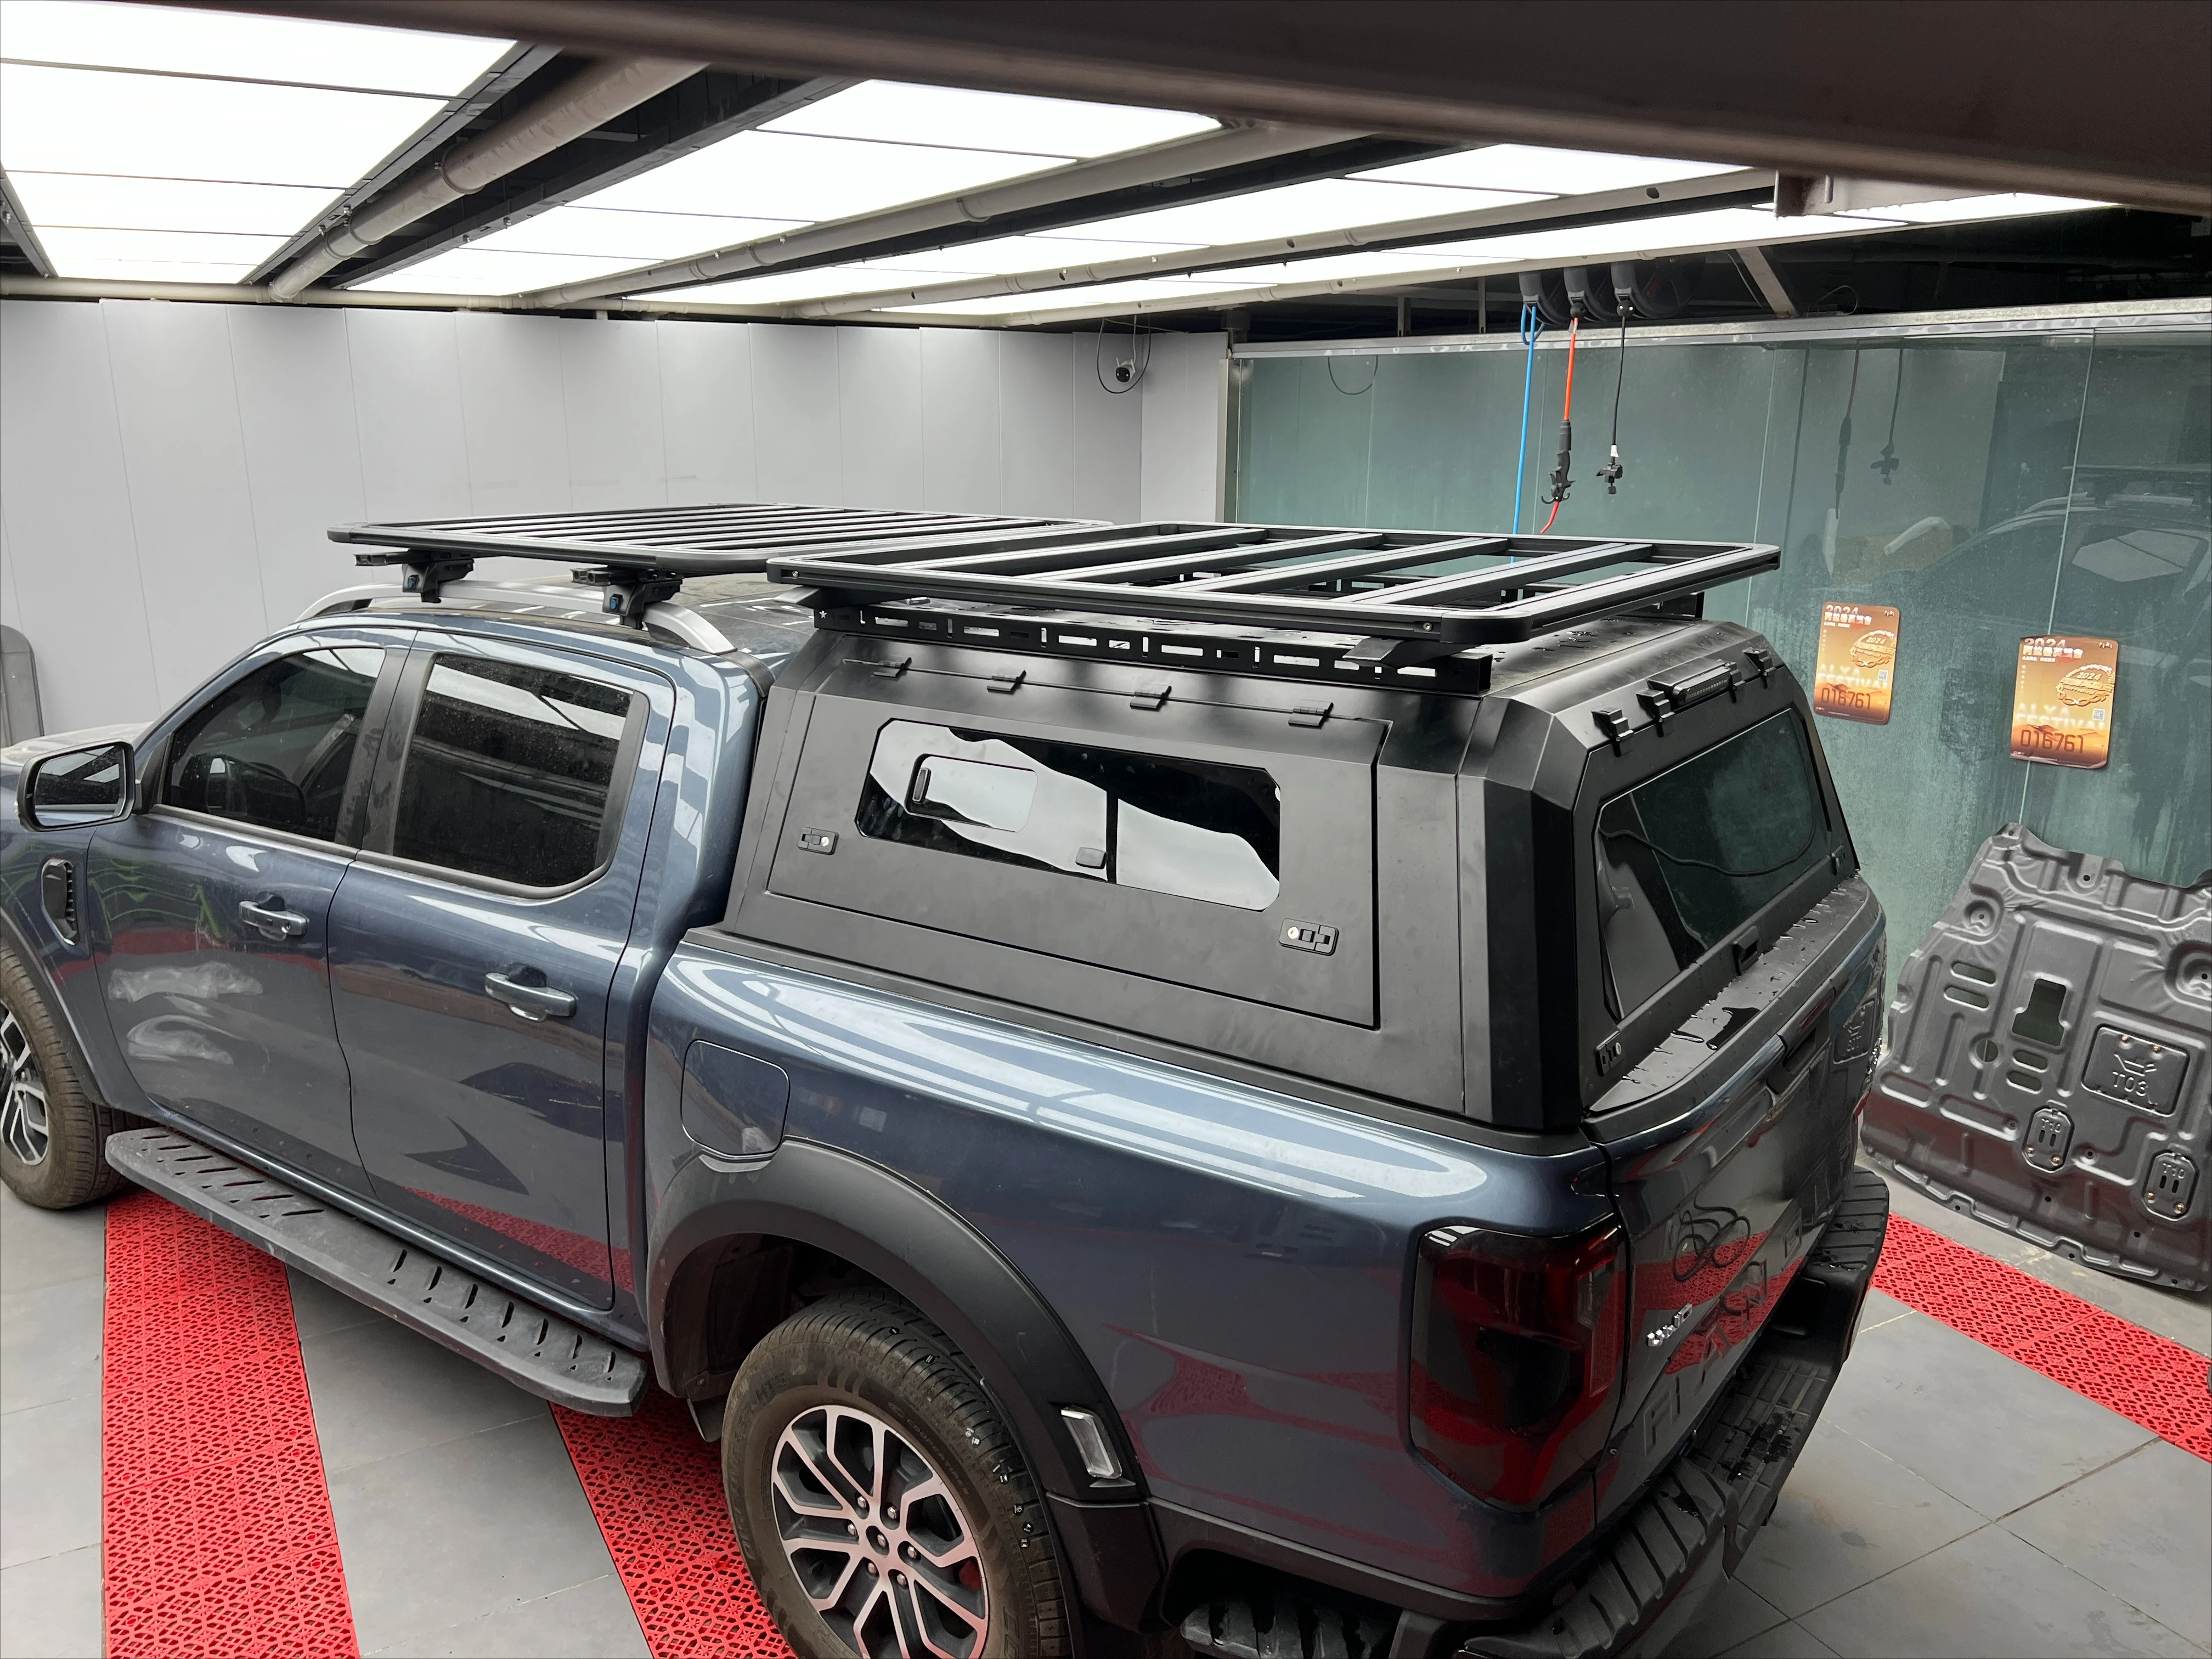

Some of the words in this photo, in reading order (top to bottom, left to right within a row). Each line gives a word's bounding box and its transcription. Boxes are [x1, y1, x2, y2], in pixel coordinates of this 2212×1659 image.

[1826, 605, 1859, 615] 2024
[2024, 637, 2066, 648] 2024
[2076, 672, 2102, 681] 2024
[1821, 687, 1871, 710] 016761
[2020, 729, 2084, 754] 016761
